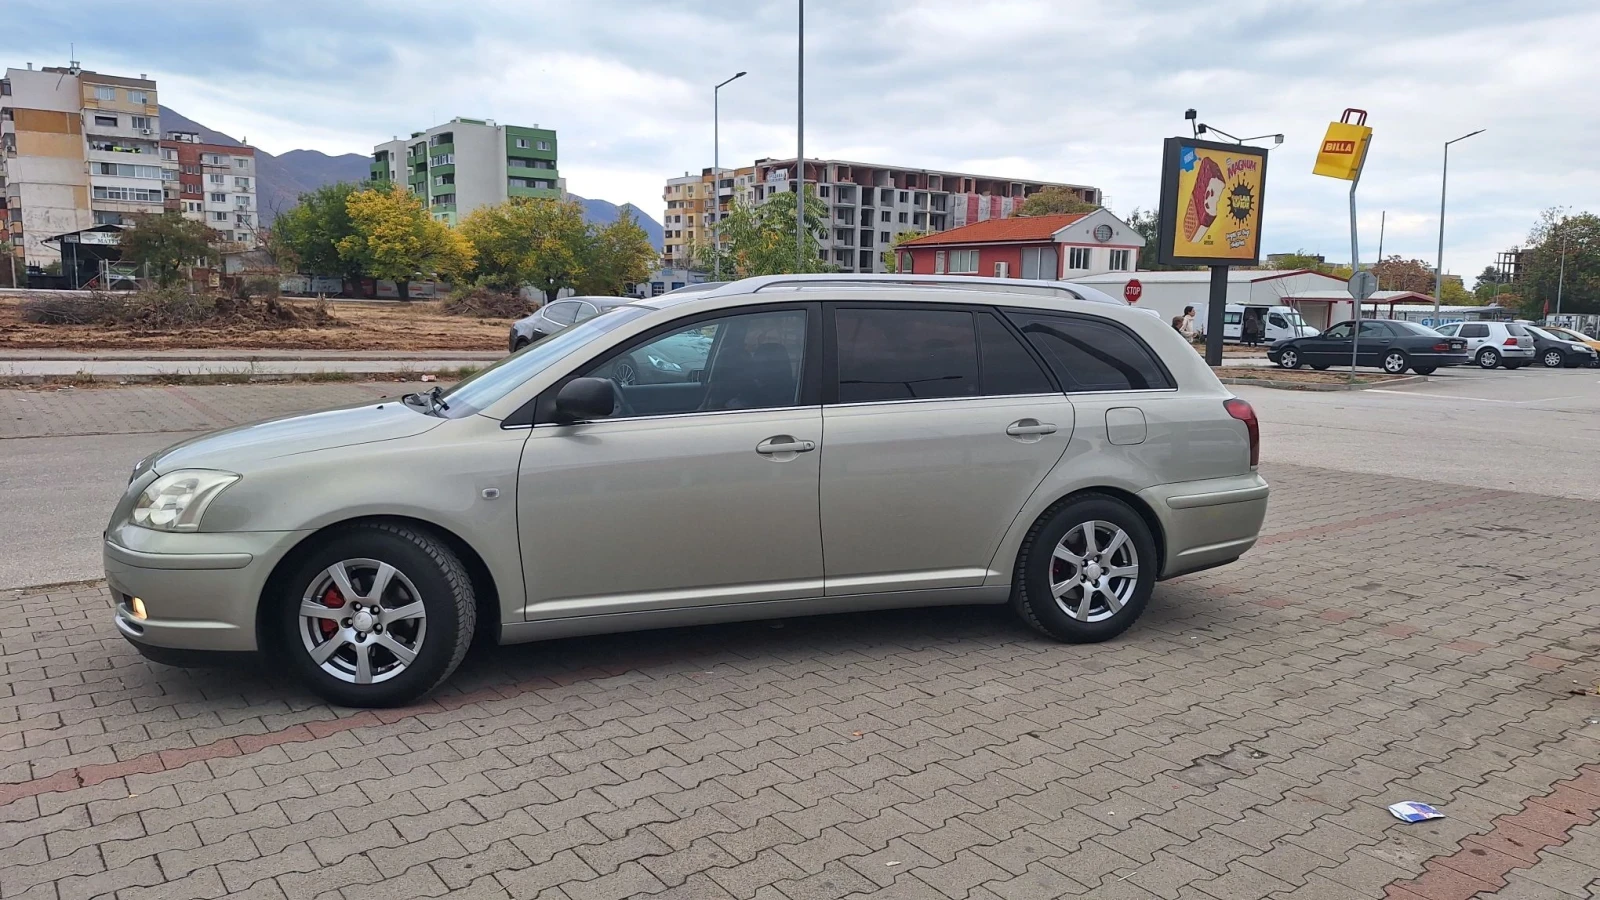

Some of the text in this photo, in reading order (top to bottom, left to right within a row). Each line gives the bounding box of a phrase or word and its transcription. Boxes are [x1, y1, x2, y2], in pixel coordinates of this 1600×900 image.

[1324, 142, 1353, 152] BILLA
[1227, 159, 1257, 179] MAGNUM
[1126, 286, 1141, 296] STOP
